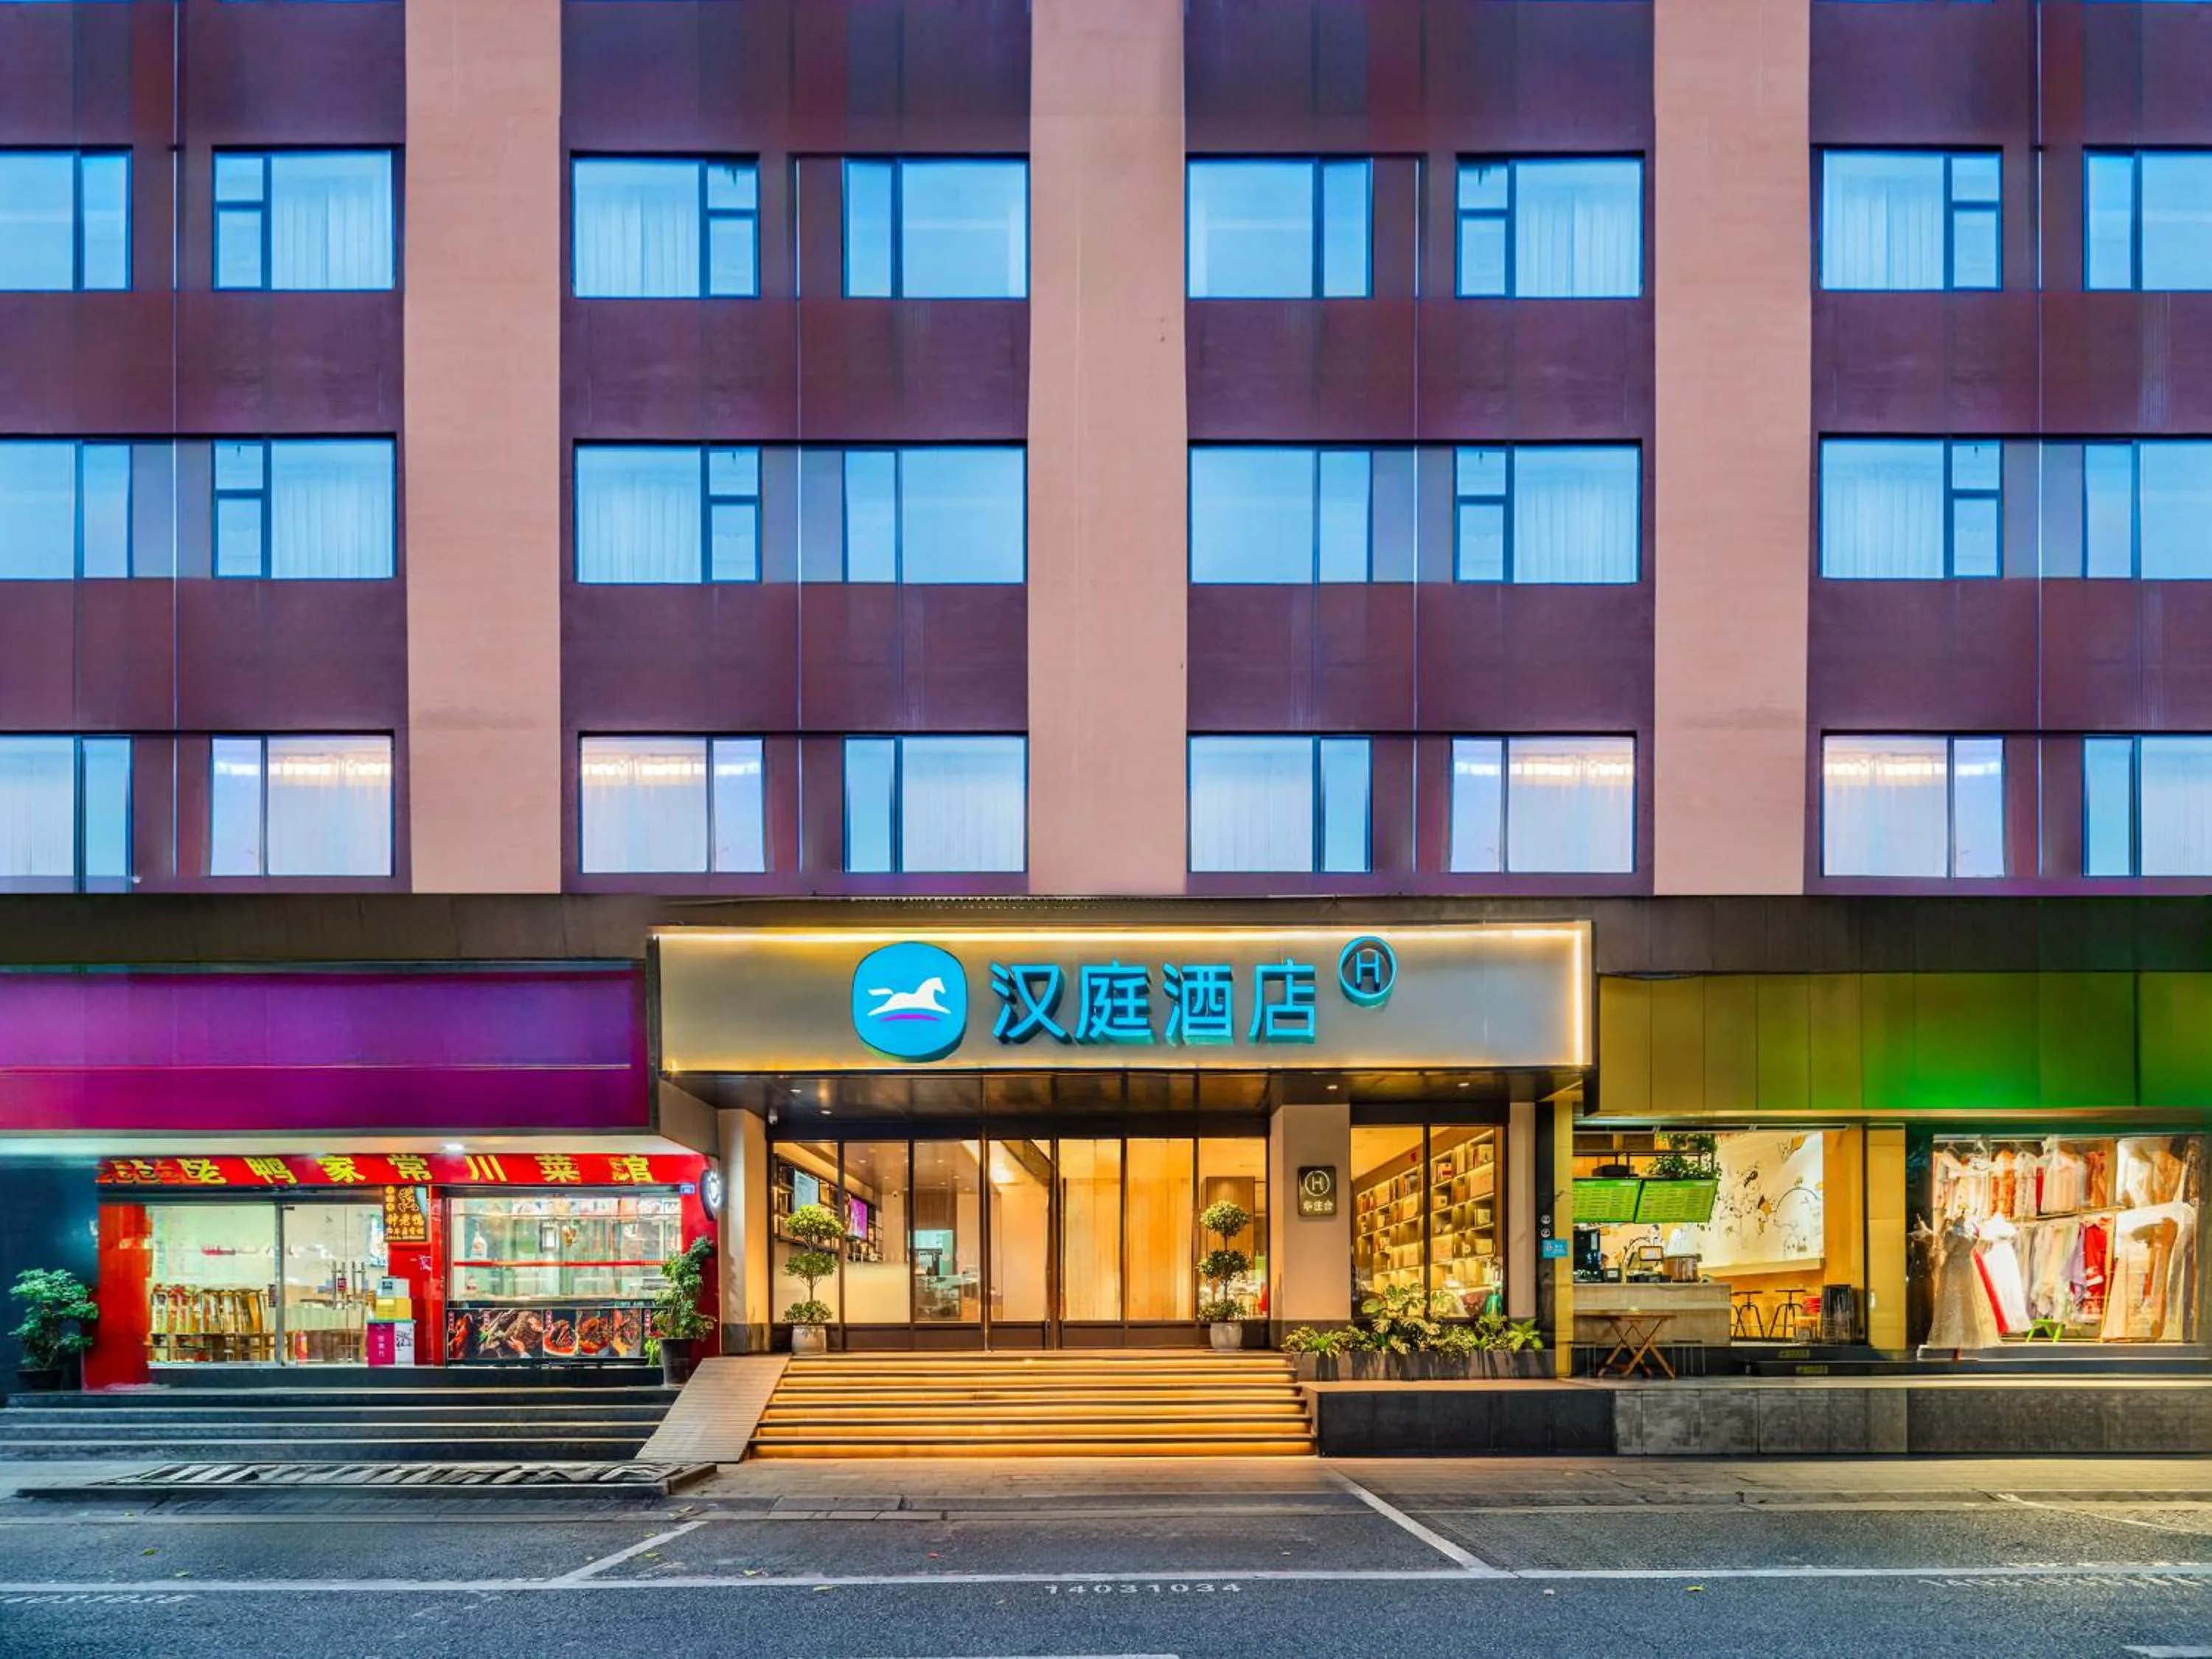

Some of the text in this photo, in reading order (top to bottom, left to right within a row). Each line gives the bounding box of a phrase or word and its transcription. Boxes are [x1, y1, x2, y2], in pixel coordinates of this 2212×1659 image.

[990, 959, 1317, 1042] 汉庭酒店
[1045, 1582, 1242, 1595] 14031034
